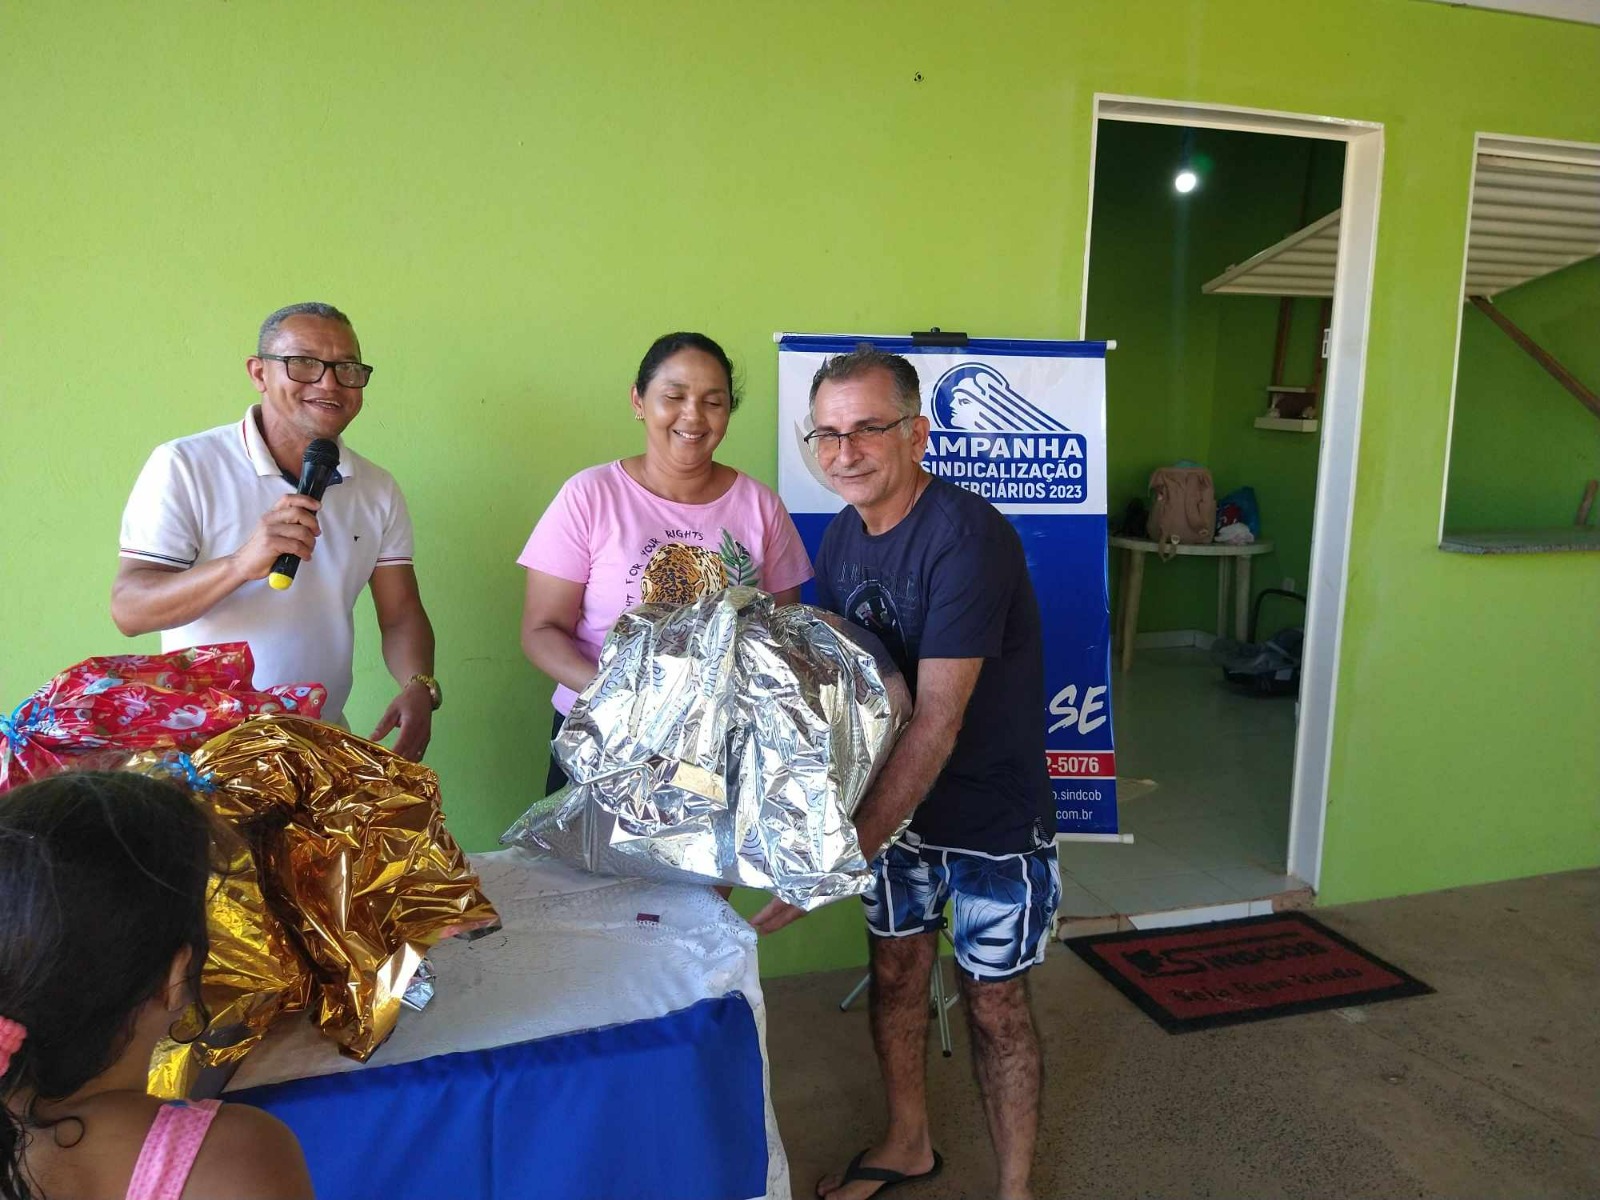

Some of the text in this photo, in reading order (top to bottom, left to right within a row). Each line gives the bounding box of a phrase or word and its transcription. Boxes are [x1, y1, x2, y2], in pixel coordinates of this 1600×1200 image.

[925, 436, 1083, 459] AMPANHA
[920, 460, 1082, 482] SINDICALIZAÇÃO
[955, 479, 1082, 499] ERCIÁRIOS 2023
[640, 537, 661, 557] YOUR
[665, 529, 704, 541] RIGHTS
[1048, 684, 1107, 735] SE
